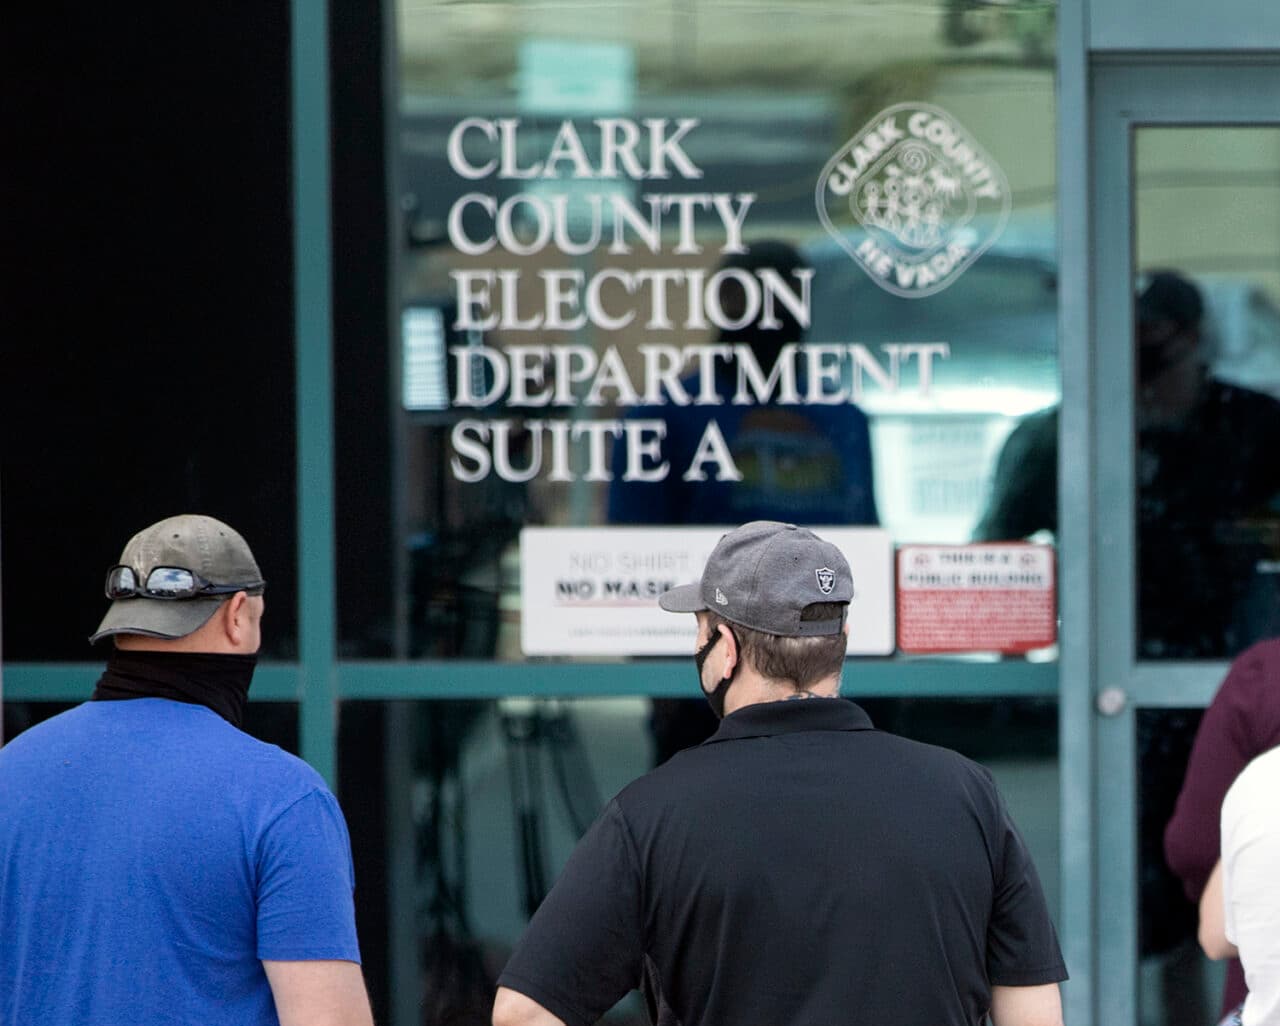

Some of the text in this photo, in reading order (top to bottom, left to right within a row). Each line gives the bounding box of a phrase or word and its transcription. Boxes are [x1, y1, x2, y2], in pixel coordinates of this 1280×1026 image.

[446, 117, 704, 180] CLARK
[828, 112, 1000, 199] CLARK COUNTY
[446, 192, 756, 255] COUNTY
[856, 228, 977, 288] NEVADA
[449, 268, 815, 332] ELECTION
[449, 342, 950, 407] DEPARTMENT
[450, 418, 744, 483] SUITE A
[556, 579, 595, 599] NO
